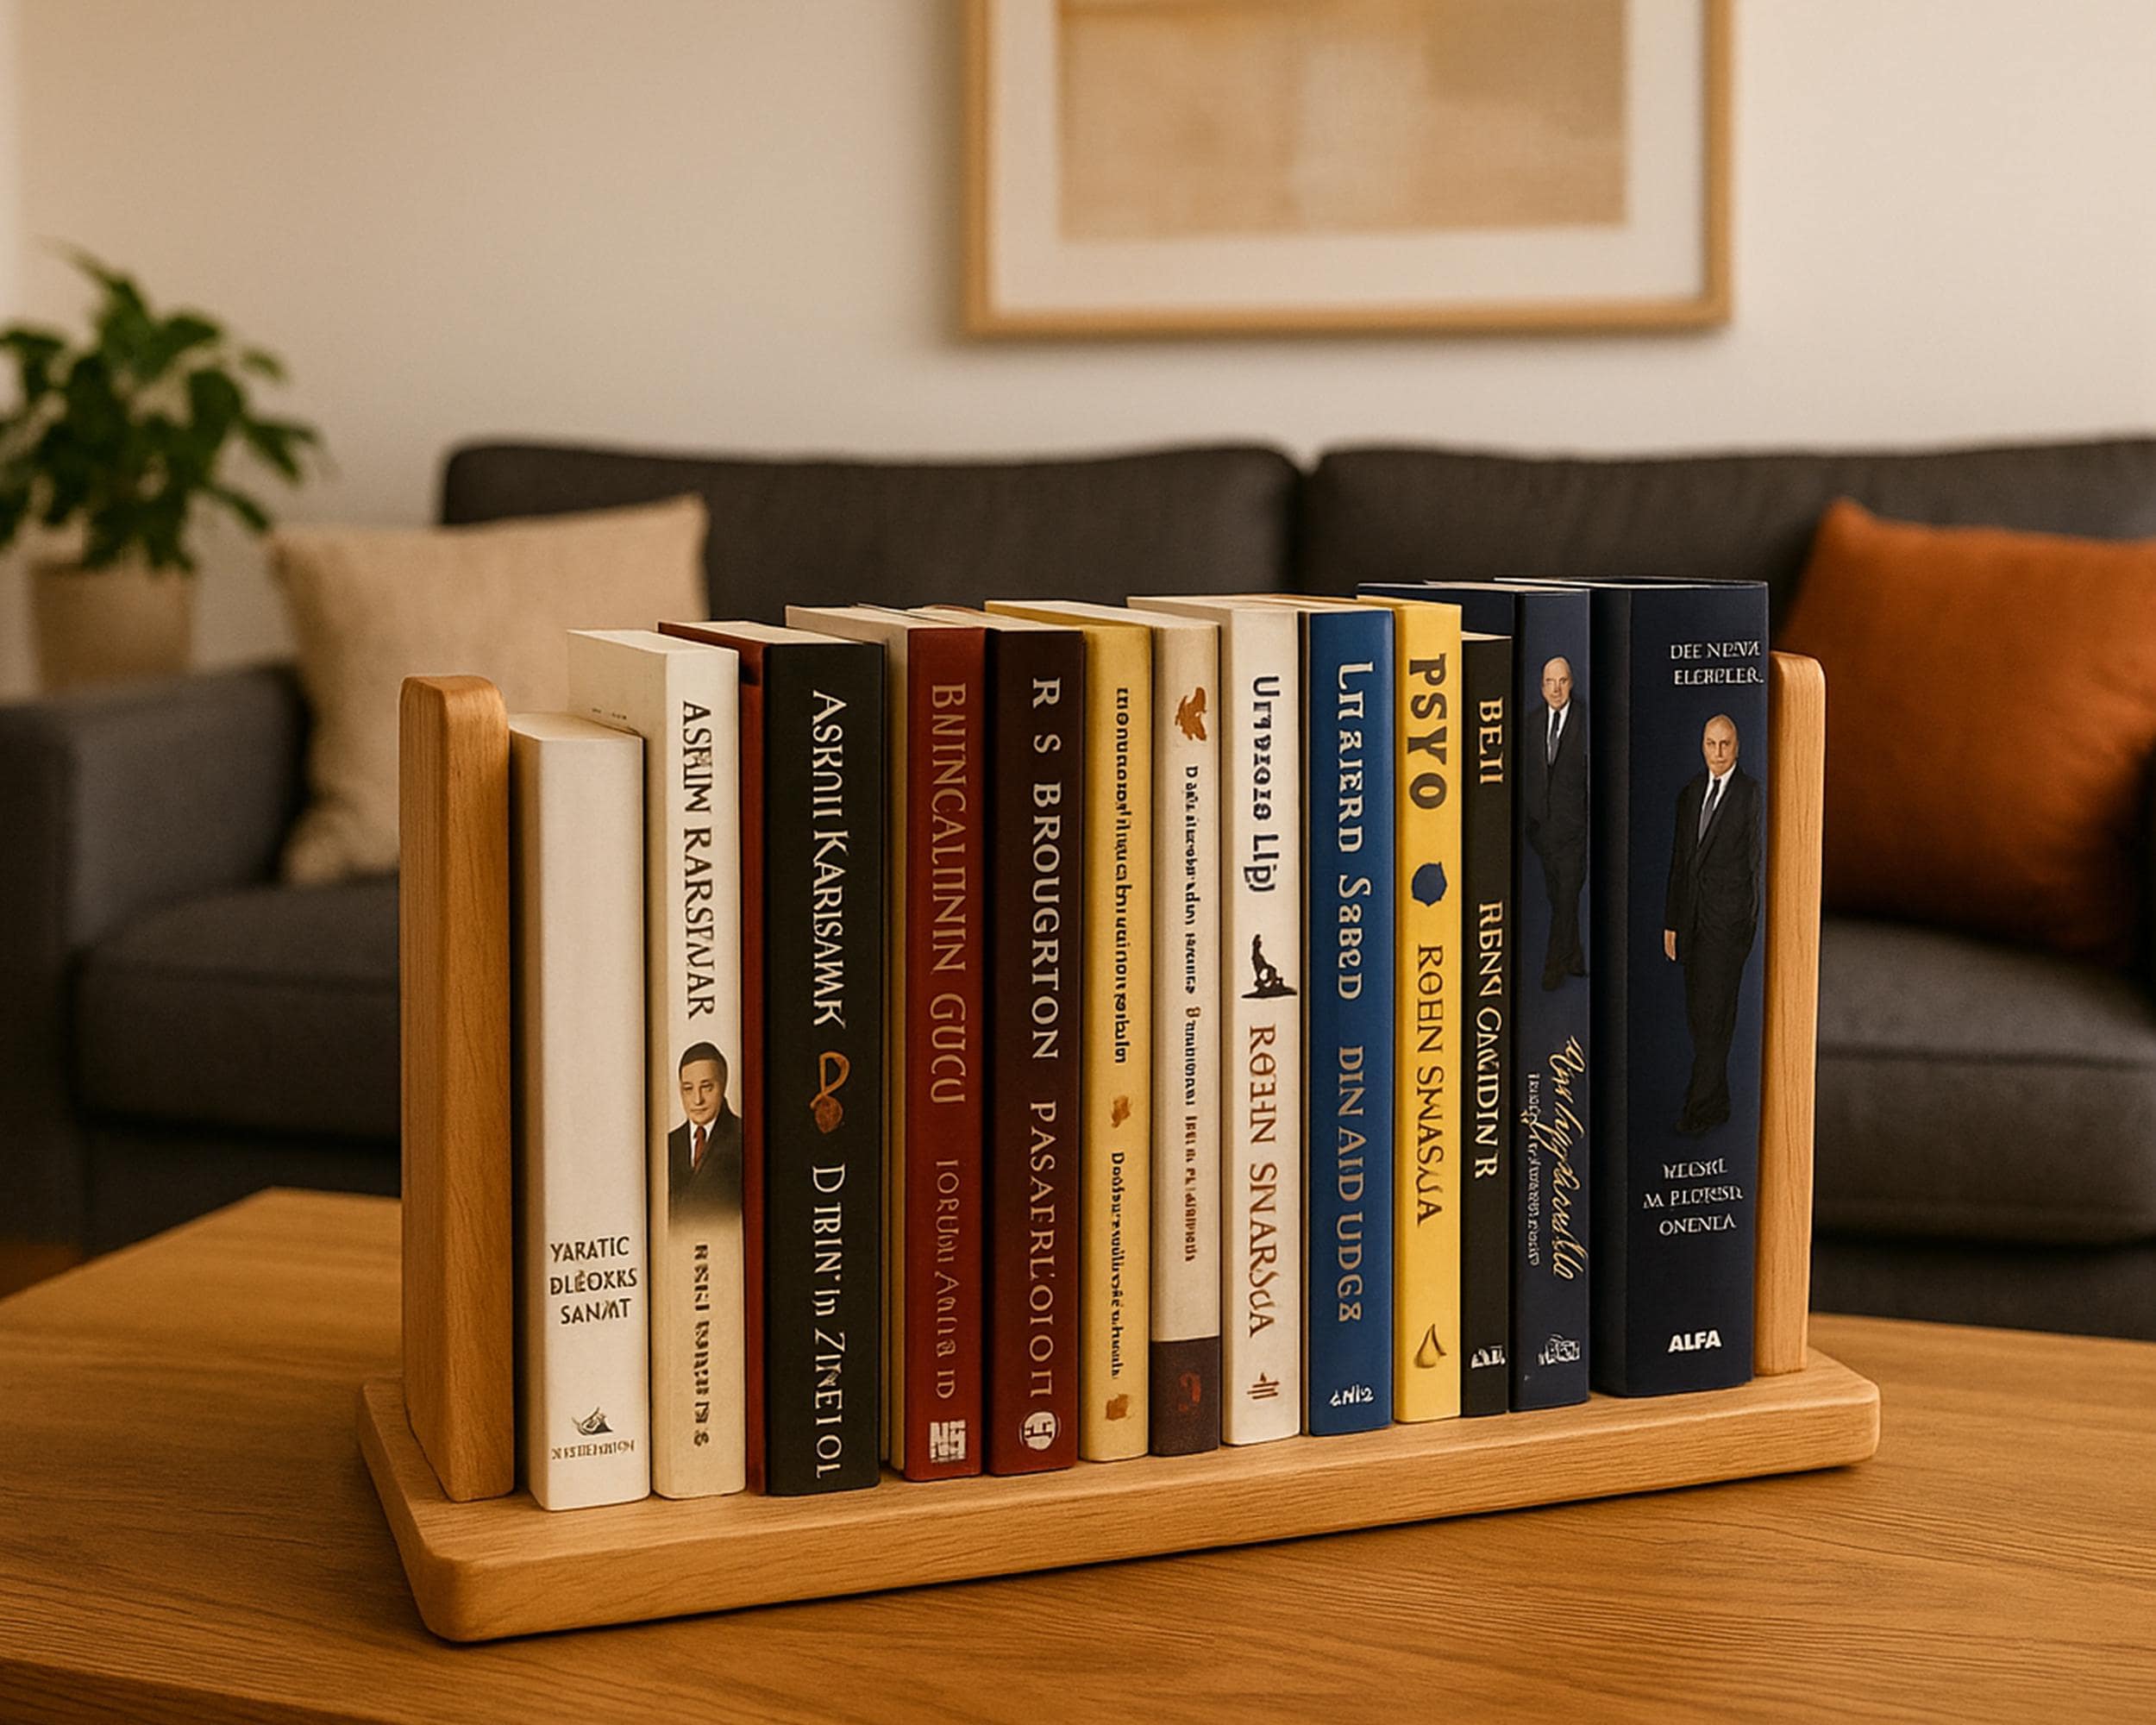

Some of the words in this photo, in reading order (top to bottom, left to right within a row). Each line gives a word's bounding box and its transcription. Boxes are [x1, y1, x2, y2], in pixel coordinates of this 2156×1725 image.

[1033, 677, 1061, 709] R
[1033, 733, 1062, 754] S
[1407, 652, 1447, 810] PSYO
[1031, 781, 1062, 1061] BROUGRTON
[549, 1236, 630, 1264] YARATIC
[1667, 1330, 1723, 1353] ALFA
